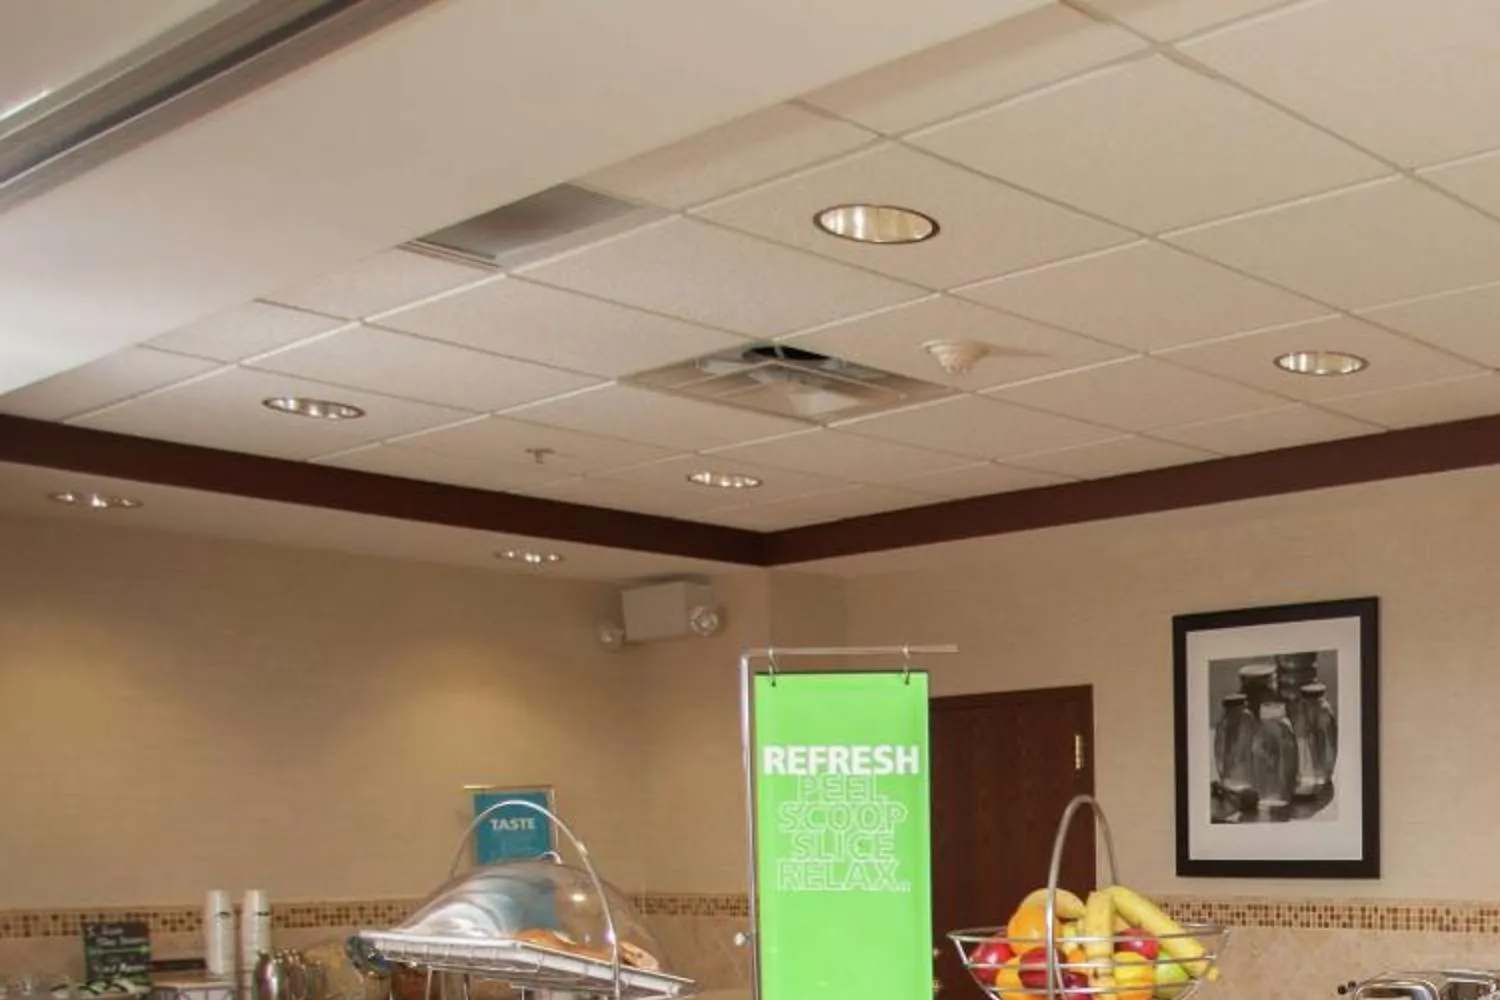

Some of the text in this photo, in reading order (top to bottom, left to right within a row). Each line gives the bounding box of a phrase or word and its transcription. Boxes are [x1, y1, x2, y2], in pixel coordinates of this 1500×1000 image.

[763, 745, 919, 775] REFRESH
[798, 775, 888, 803] PEEL
[489, 817, 536, 831] TASTE
[780, 801, 908, 833] SCOOP
[793, 831, 896, 862] SLICE
